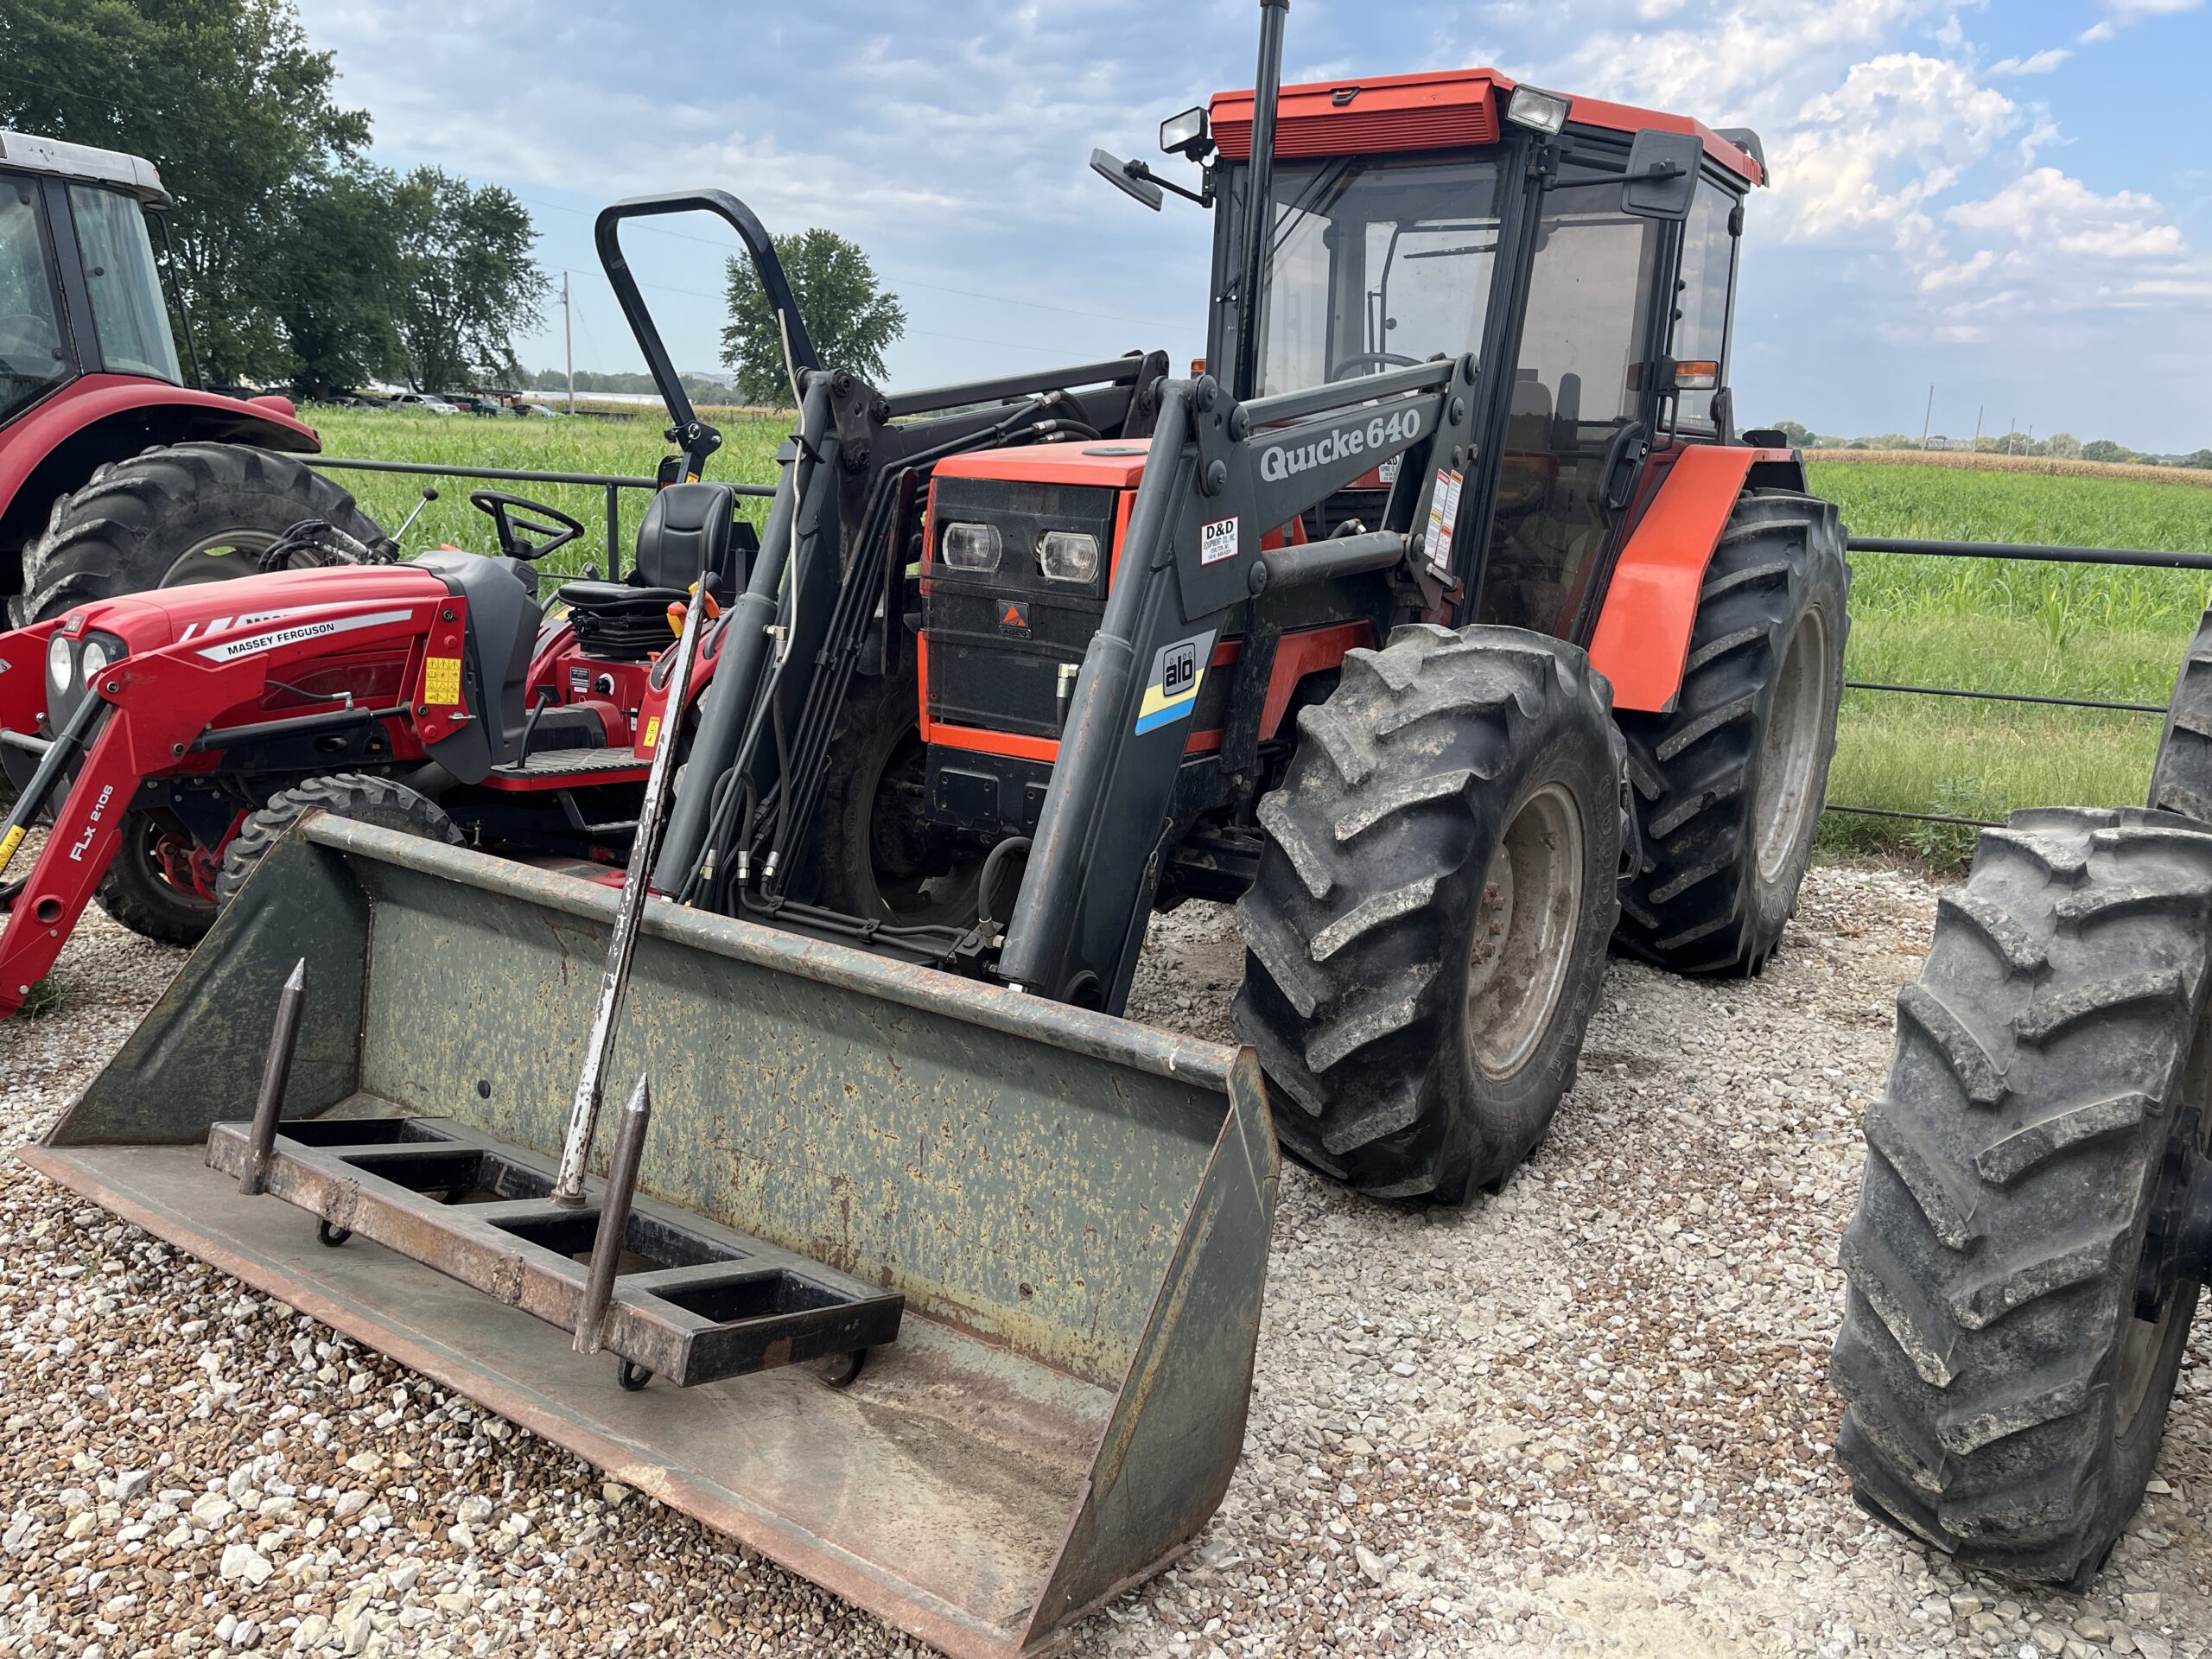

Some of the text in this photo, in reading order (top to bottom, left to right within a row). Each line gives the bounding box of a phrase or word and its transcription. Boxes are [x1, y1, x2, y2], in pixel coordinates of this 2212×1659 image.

[1261, 409, 1421, 482] Quicke 640
[1206, 520, 1234, 539] D&D
[227, 622, 335, 656] MASSEY FERGUSON
[1002, 628, 1027, 637] AGCO
[69, 784, 114, 862] FLX 2106
